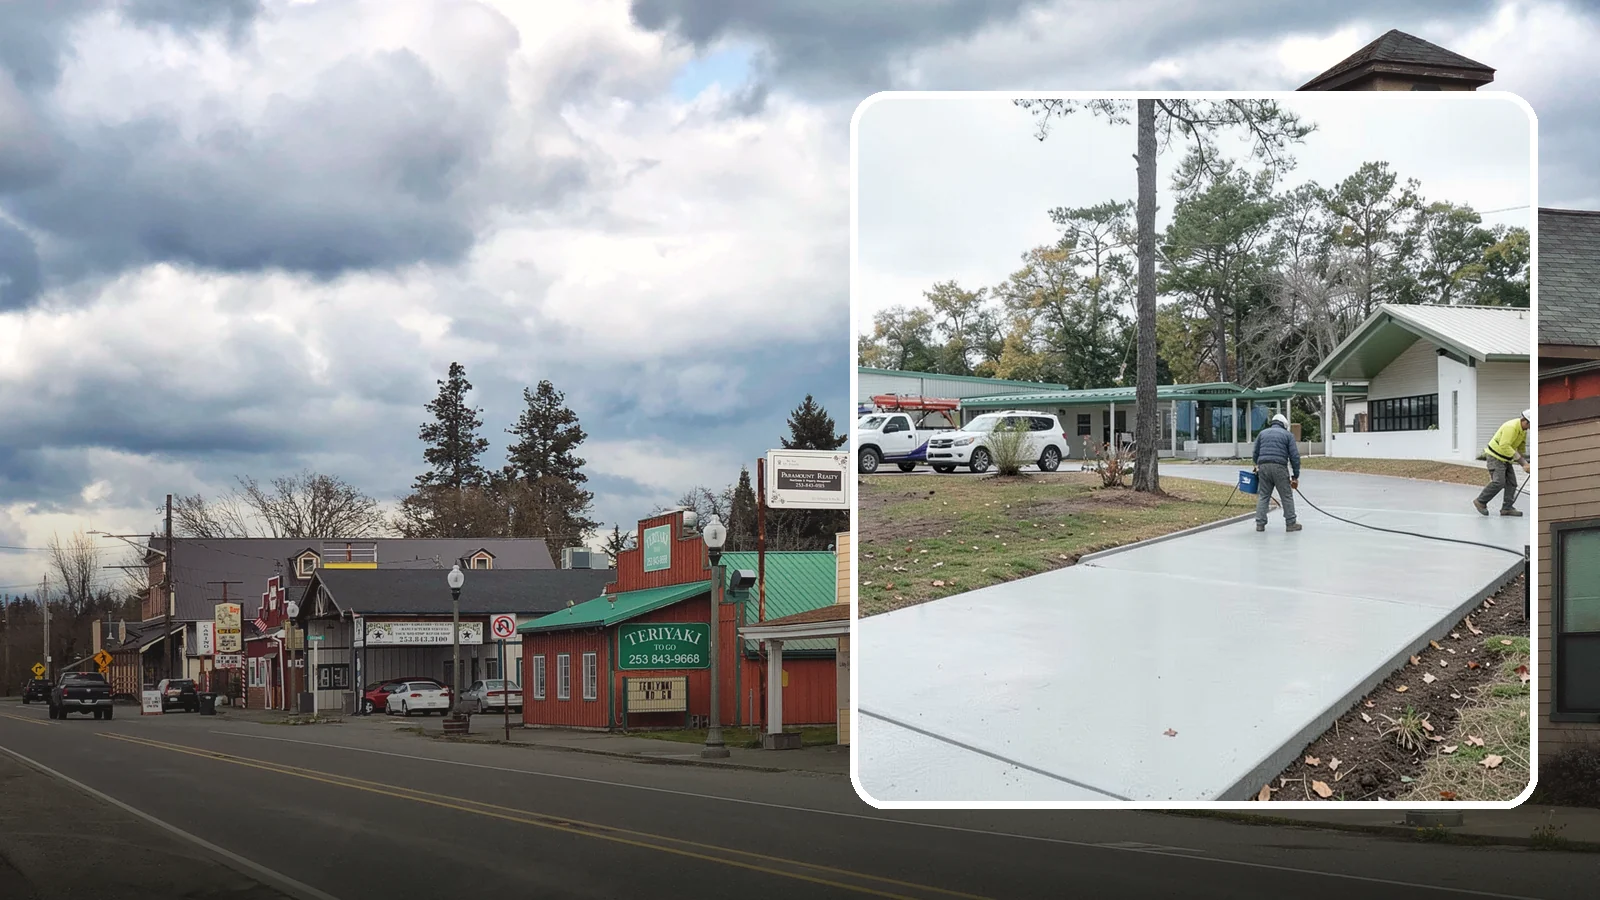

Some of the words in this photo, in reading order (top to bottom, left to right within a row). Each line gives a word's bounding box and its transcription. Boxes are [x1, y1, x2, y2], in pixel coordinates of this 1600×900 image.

[781, 471, 815, 479] PARAMOUNT
[817, 472, 838, 480] REALTY
[625, 627, 702, 646] TERIYAKI
[629, 654, 648, 664] 253
[651, 654, 700, 664] 843-9668
